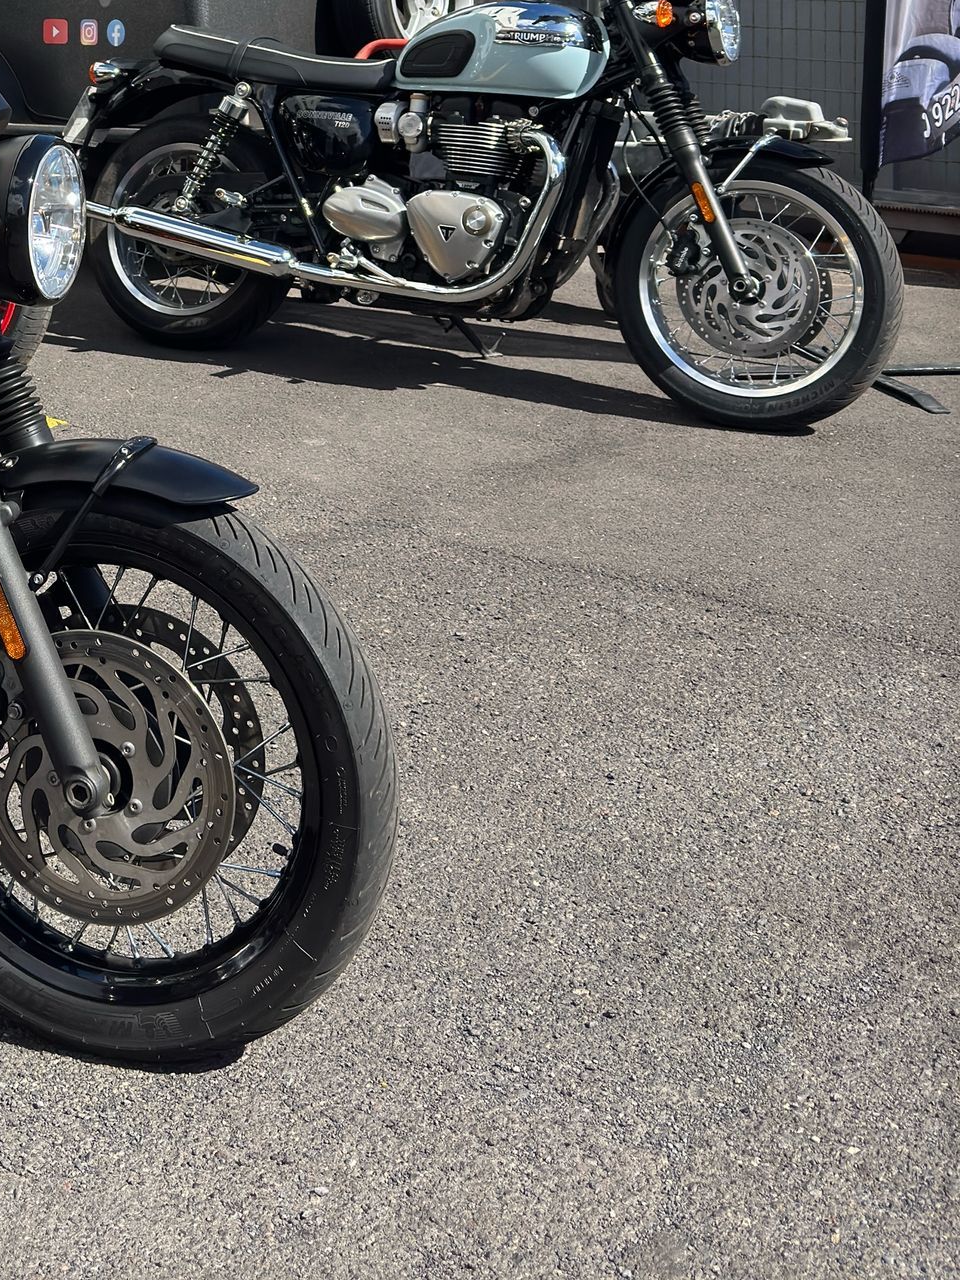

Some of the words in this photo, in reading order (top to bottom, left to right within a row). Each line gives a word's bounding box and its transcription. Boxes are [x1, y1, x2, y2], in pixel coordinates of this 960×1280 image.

[509, 32, 554, 42] TRIUMPH
[296, 109, 353, 121] BONNEVILLE
[334, 120, 350, 128] T120
